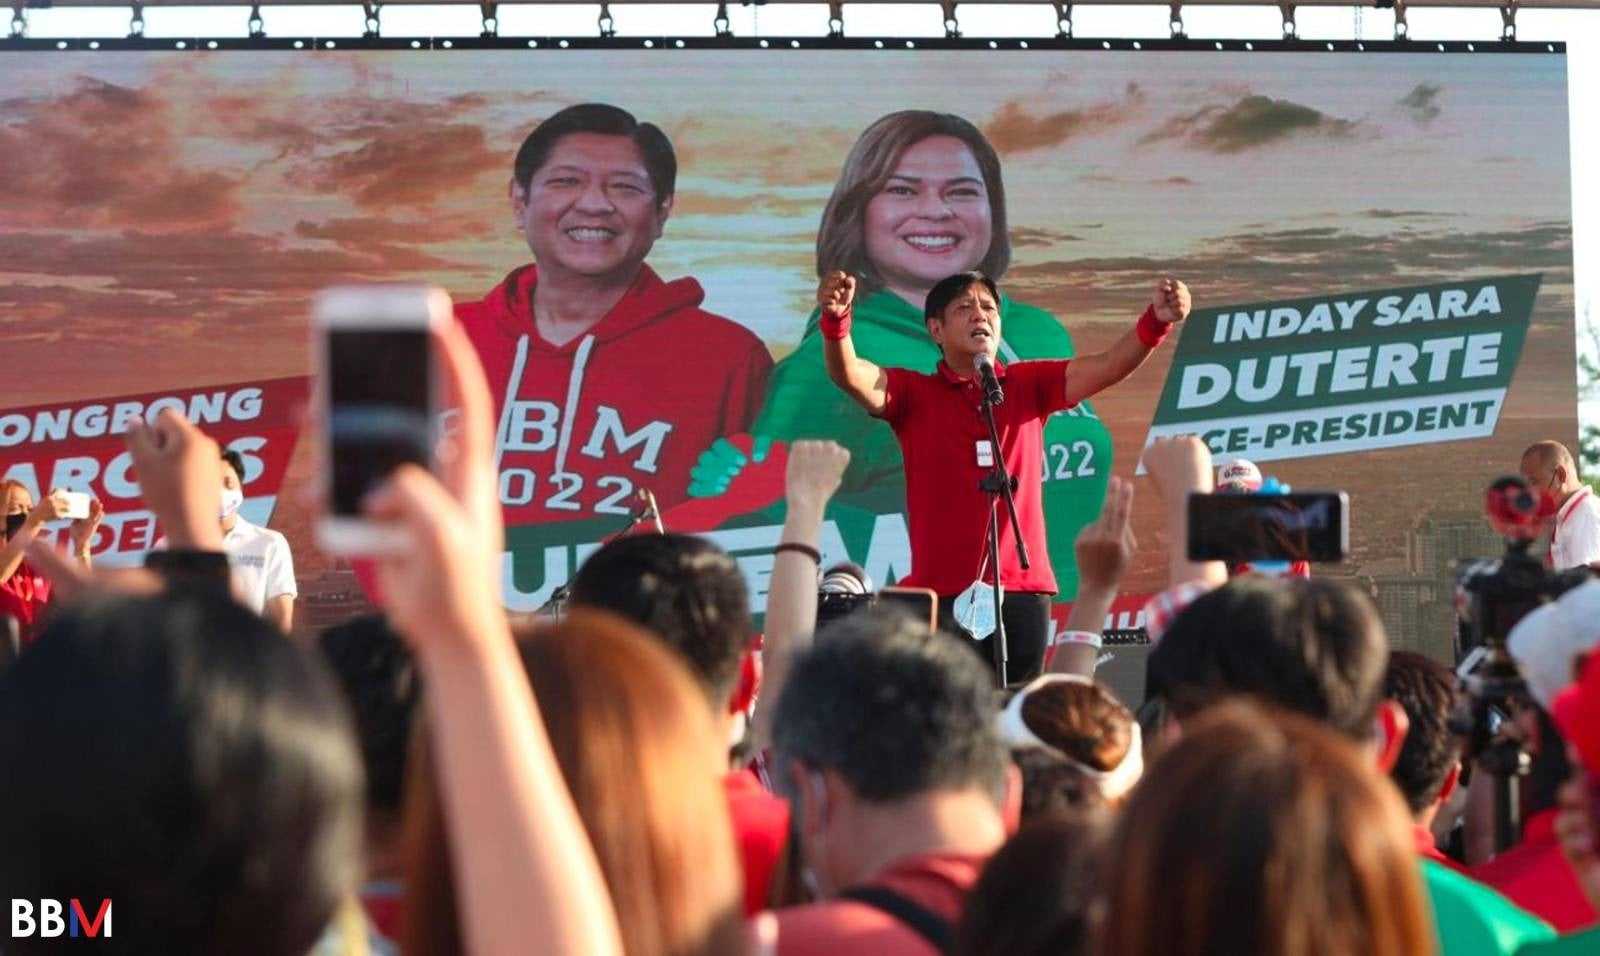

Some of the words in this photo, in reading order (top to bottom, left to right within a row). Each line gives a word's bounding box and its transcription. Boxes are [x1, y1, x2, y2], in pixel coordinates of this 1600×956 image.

[1213, 299, 1368, 344] INDAY
[1373, 286, 1502, 326] SARA
[1177, 332, 1502, 409] DUTERTE
[1154, 400, 1495, 456] CE-PRESIDENT
[1, 436, 267, 506] ARCS
[500, 467, 634, 515] 022
